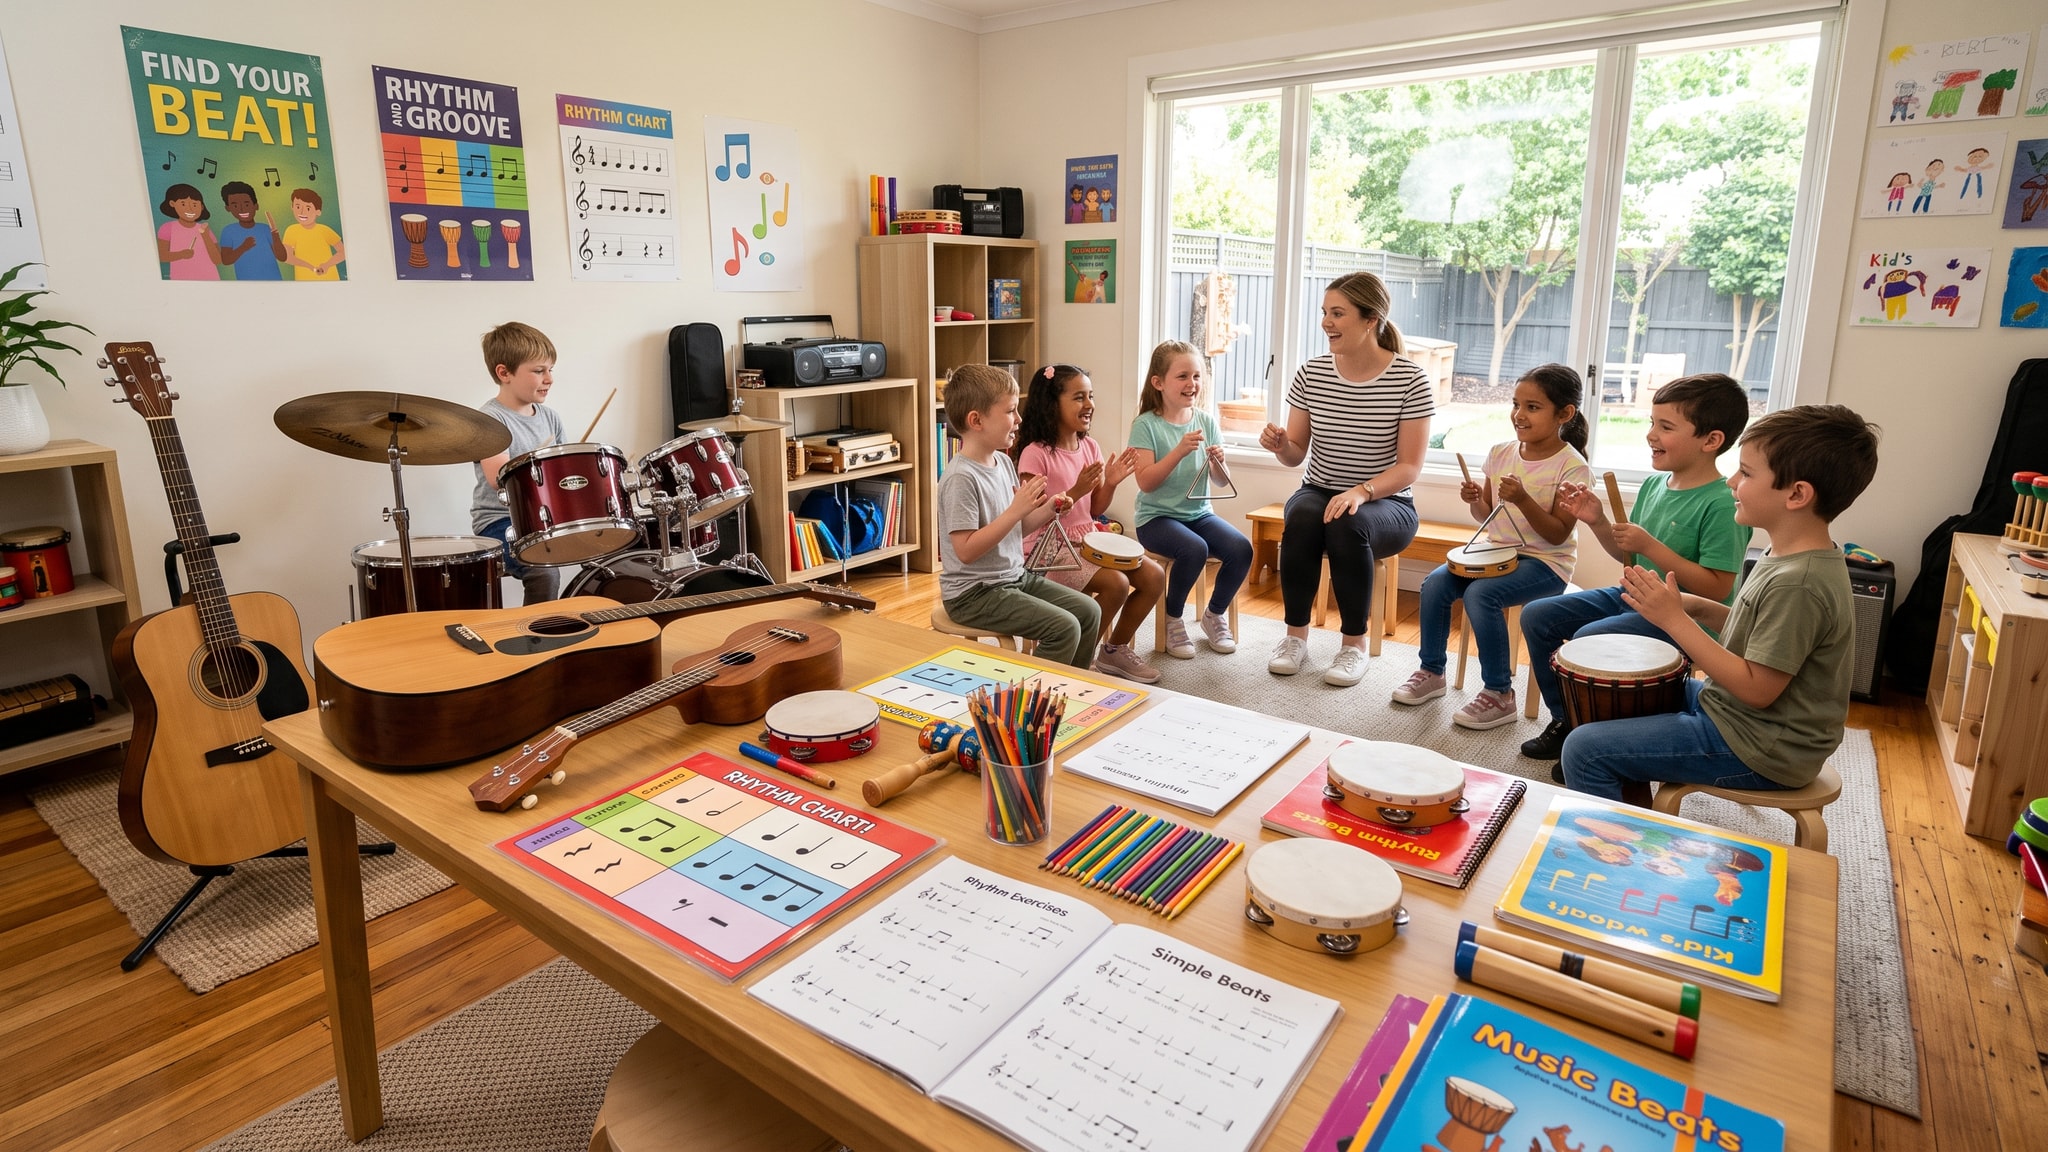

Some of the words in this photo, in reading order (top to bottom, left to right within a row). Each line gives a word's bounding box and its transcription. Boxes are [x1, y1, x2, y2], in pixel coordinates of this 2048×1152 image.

[141, 50, 220, 85] FIND
[227, 62, 312, 97] YOUR
[385, 76, 495, 113] RHYTHM
[148, 84, 318, 148] BEAT!
[391, 103, 403, 127] AND
[406, 106, 512, 139] GROOVE
[564, 103, 623, 125] RHYTHM
[626, 113, 667, 131] CHART
[1869, 252, 1913, 267] Kid's
[723, 770, 804, 806] RHYTHM
[800, 800, 876, 834] CHART!
[963, 876, 1010, 897] Rhythm
[1010, 892, 1069, 917] Exercises
[1659, 933, 1735, 965] Kid's
[1151, 946, 1212, 980] Simple
[1217, 974, 1272, 1004] Beats
[1473, 1022, 1598, 1092] Music
[1608, 1079, 1743, 1152] Beats
